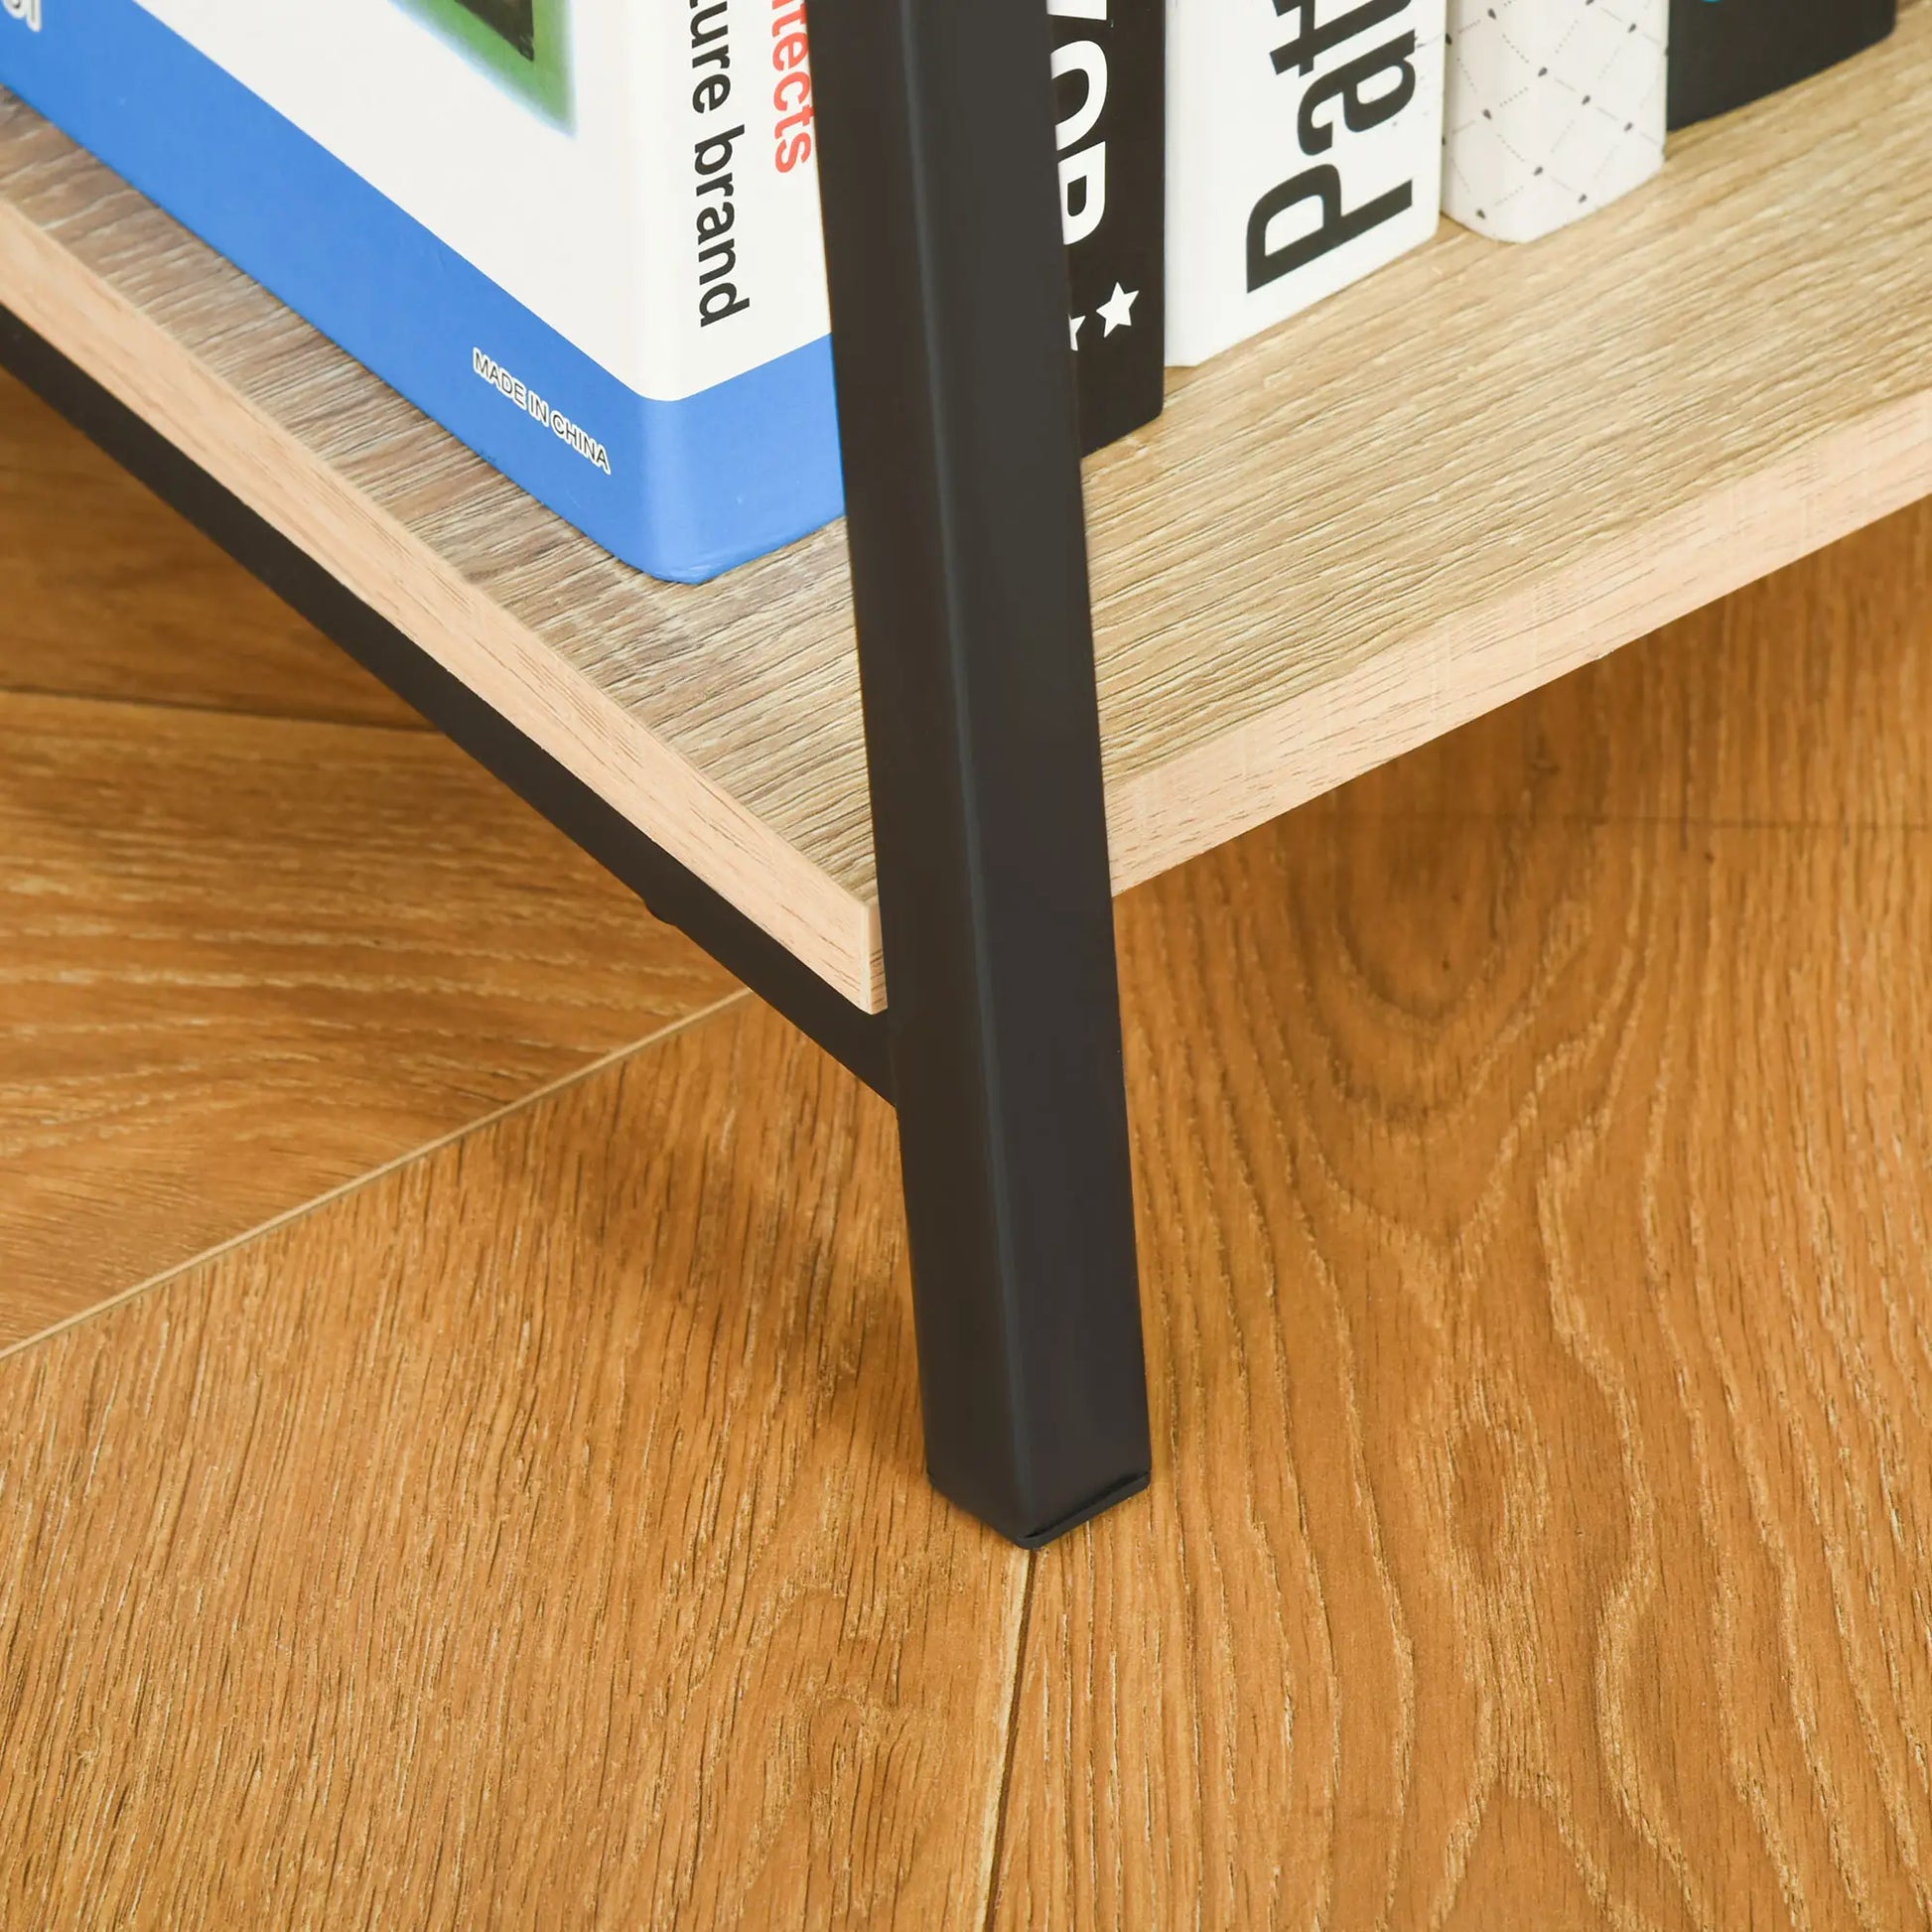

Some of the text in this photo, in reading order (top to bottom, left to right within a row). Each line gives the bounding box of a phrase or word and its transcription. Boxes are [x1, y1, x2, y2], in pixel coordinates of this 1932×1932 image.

[689, 0, 750, 328] ure brand
[1246, 0, 1416, 294] Pat
[473, 347, 611, 475] MADE IN CHINA
